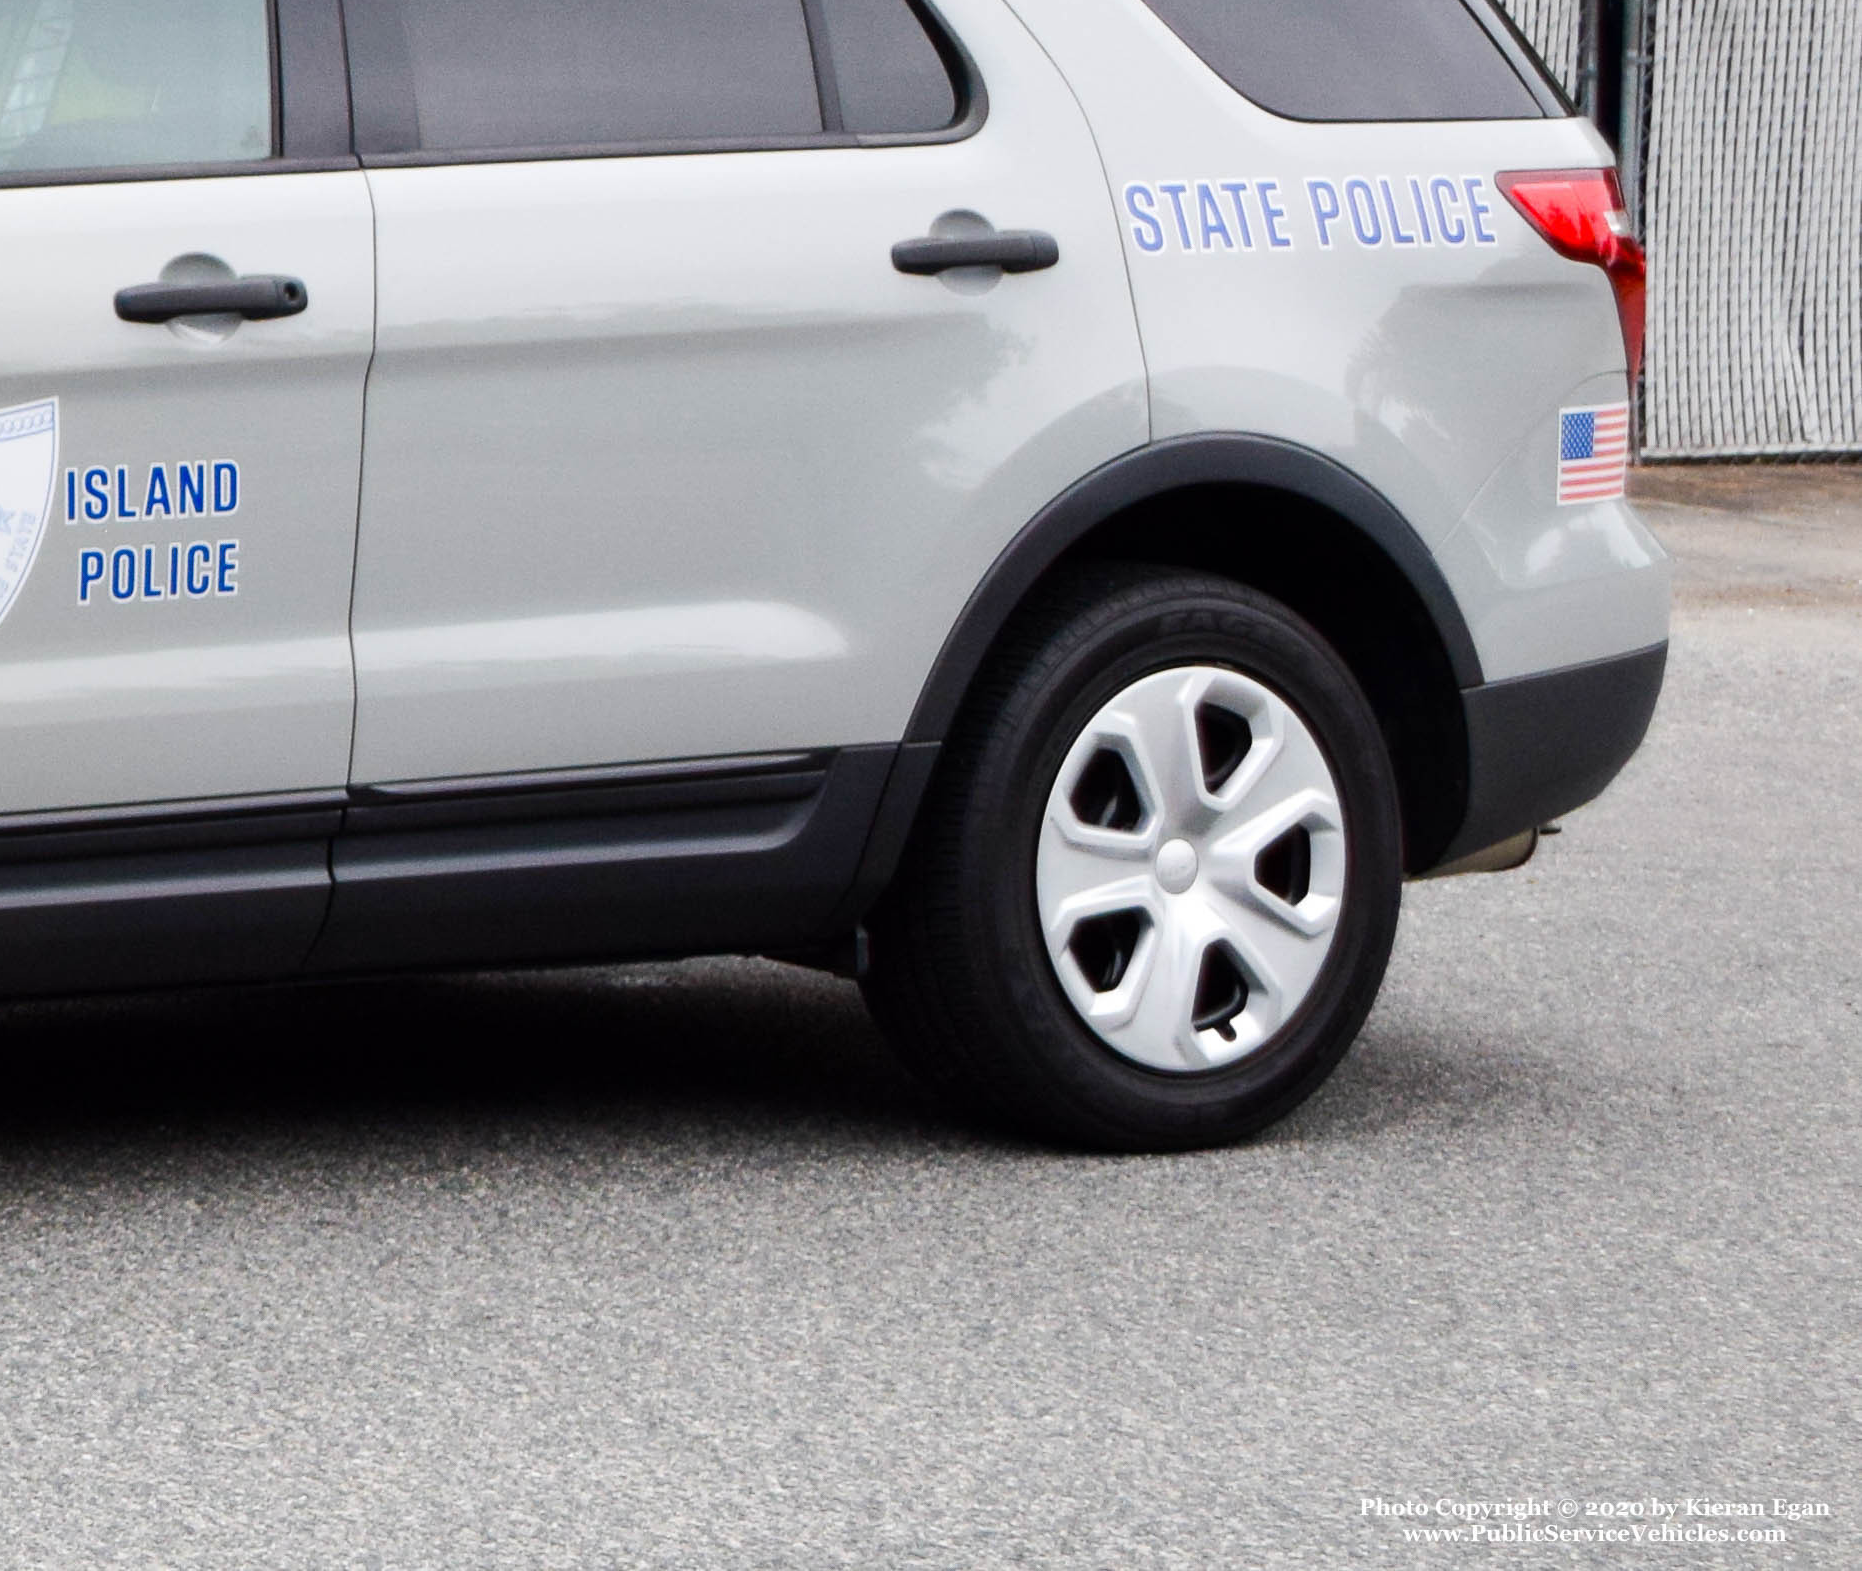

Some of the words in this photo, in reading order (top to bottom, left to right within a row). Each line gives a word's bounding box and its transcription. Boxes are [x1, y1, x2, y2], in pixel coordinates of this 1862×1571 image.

[1125, 179, 1292, 252] STATE
[1306, 177, 1496, 246] POLICE
[65, 460, 240, 522] ISLAND
[78, 541, 237, 603] POLICE
